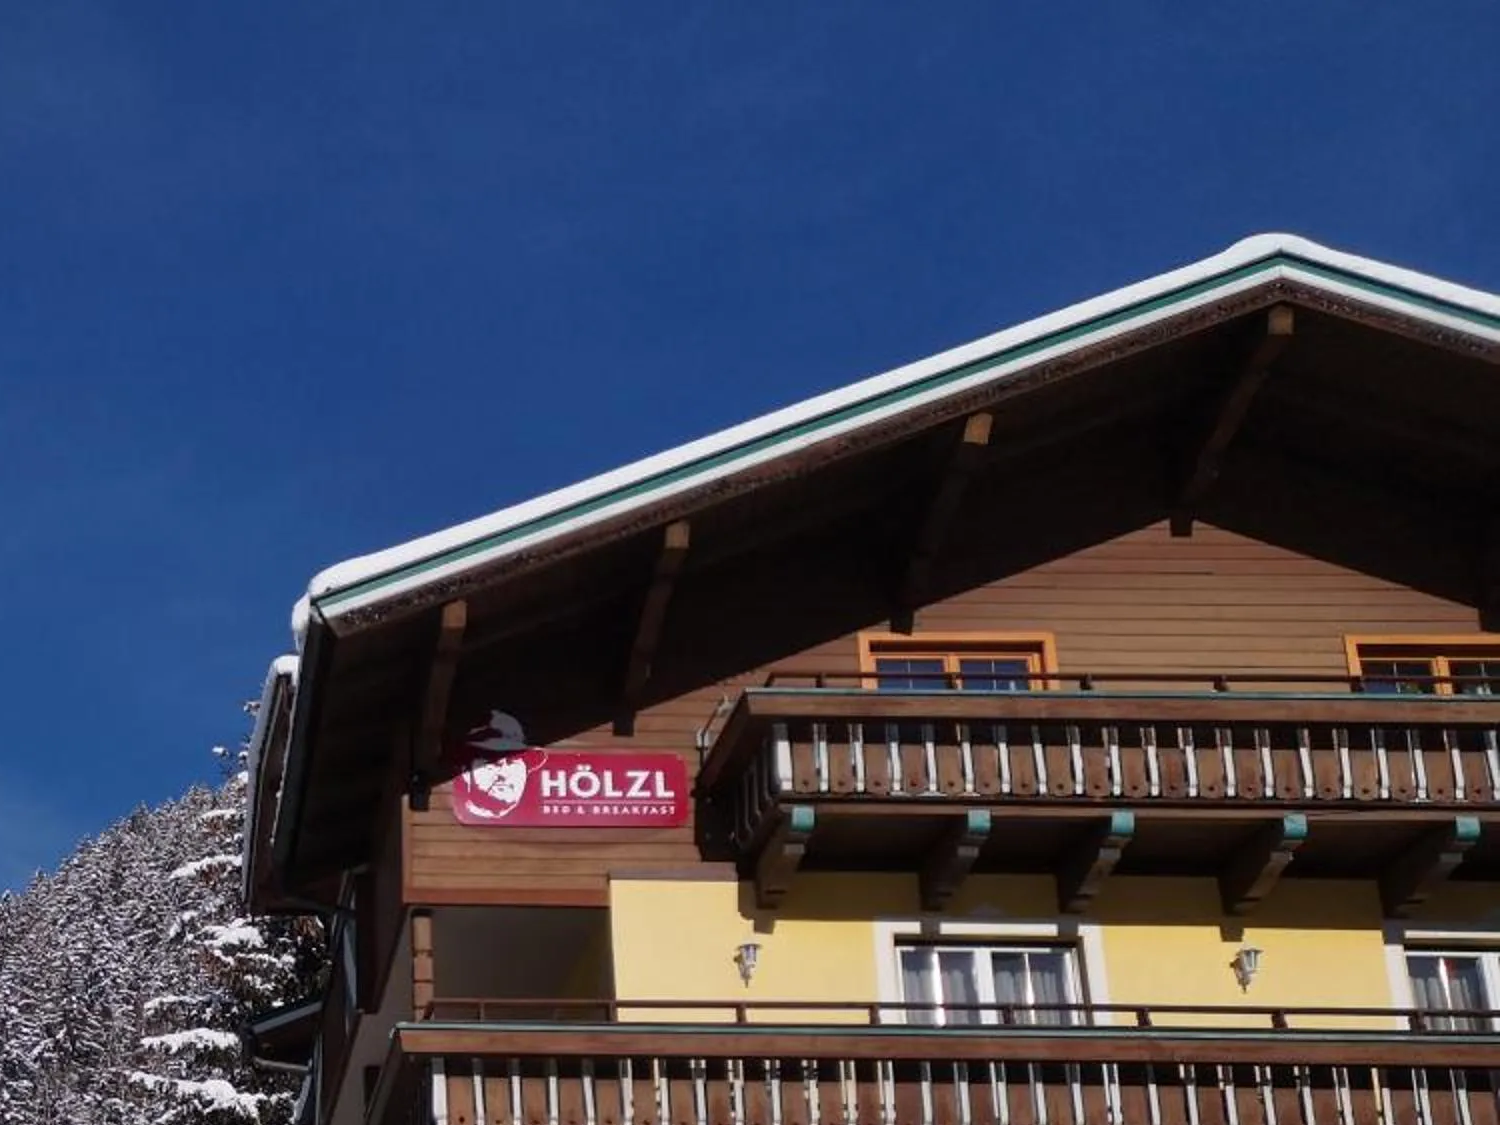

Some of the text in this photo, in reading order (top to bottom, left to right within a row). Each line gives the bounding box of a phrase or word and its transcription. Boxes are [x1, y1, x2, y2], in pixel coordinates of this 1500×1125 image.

[540, 764, 675, 798] HÖLZL
[543, 805, 676, 816] BED & BREAKFAST
